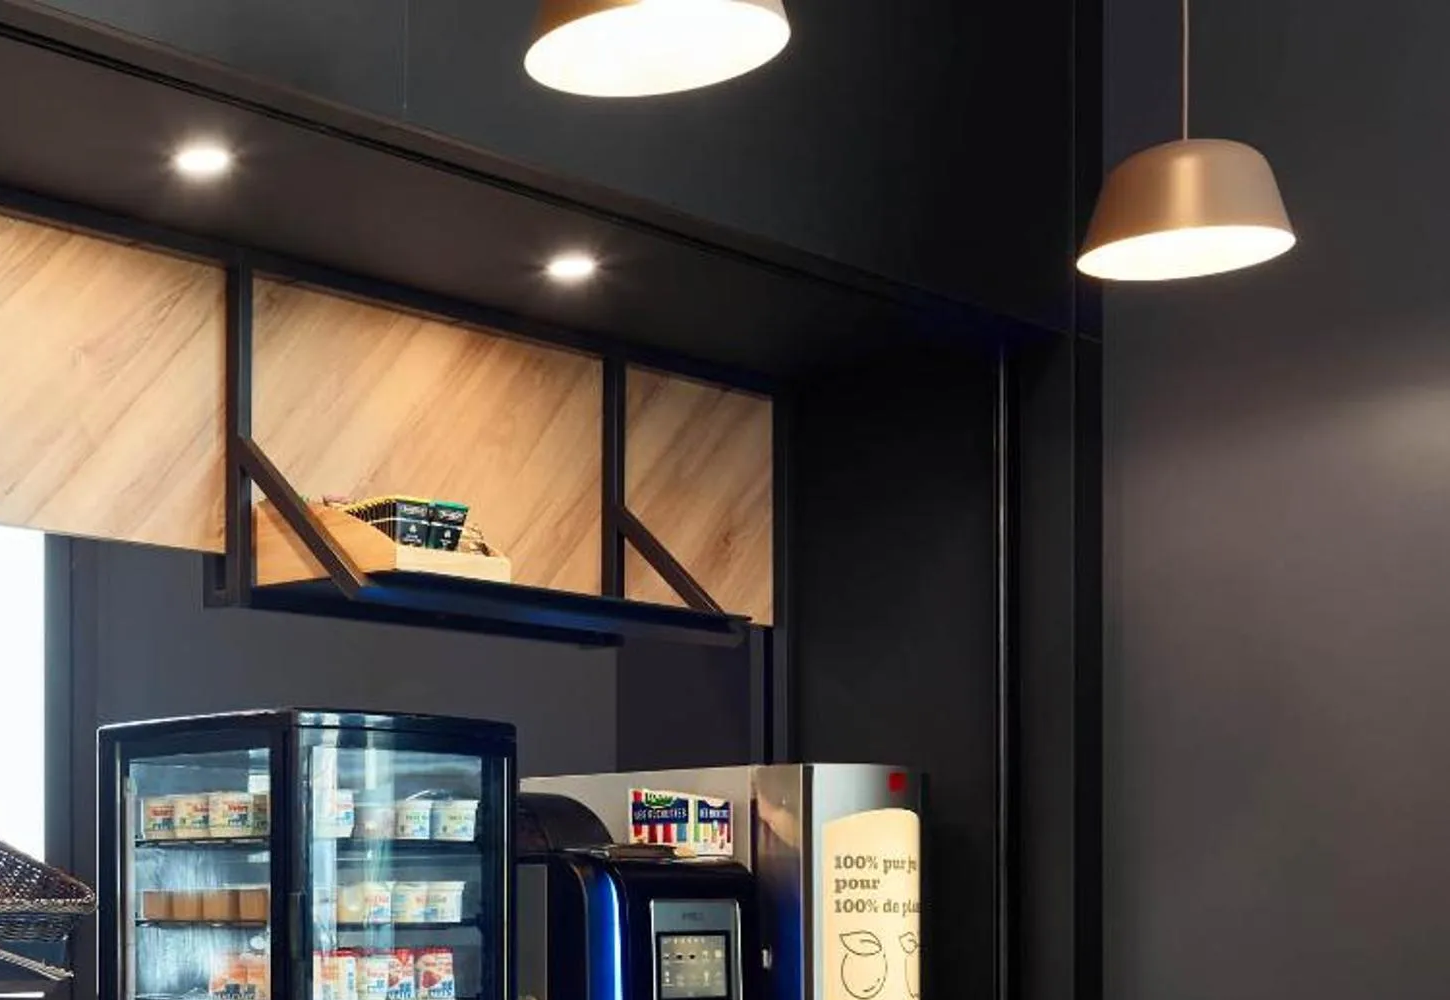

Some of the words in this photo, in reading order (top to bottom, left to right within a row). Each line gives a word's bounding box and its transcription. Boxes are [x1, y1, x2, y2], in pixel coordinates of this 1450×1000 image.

[835, 855, 878, 870] 100%
[883, 859, 906, 875] pur
[835, 878, 880, 894] pour
[835, 899, 878, 913] 100%
[883, 899, 899, 913] de
